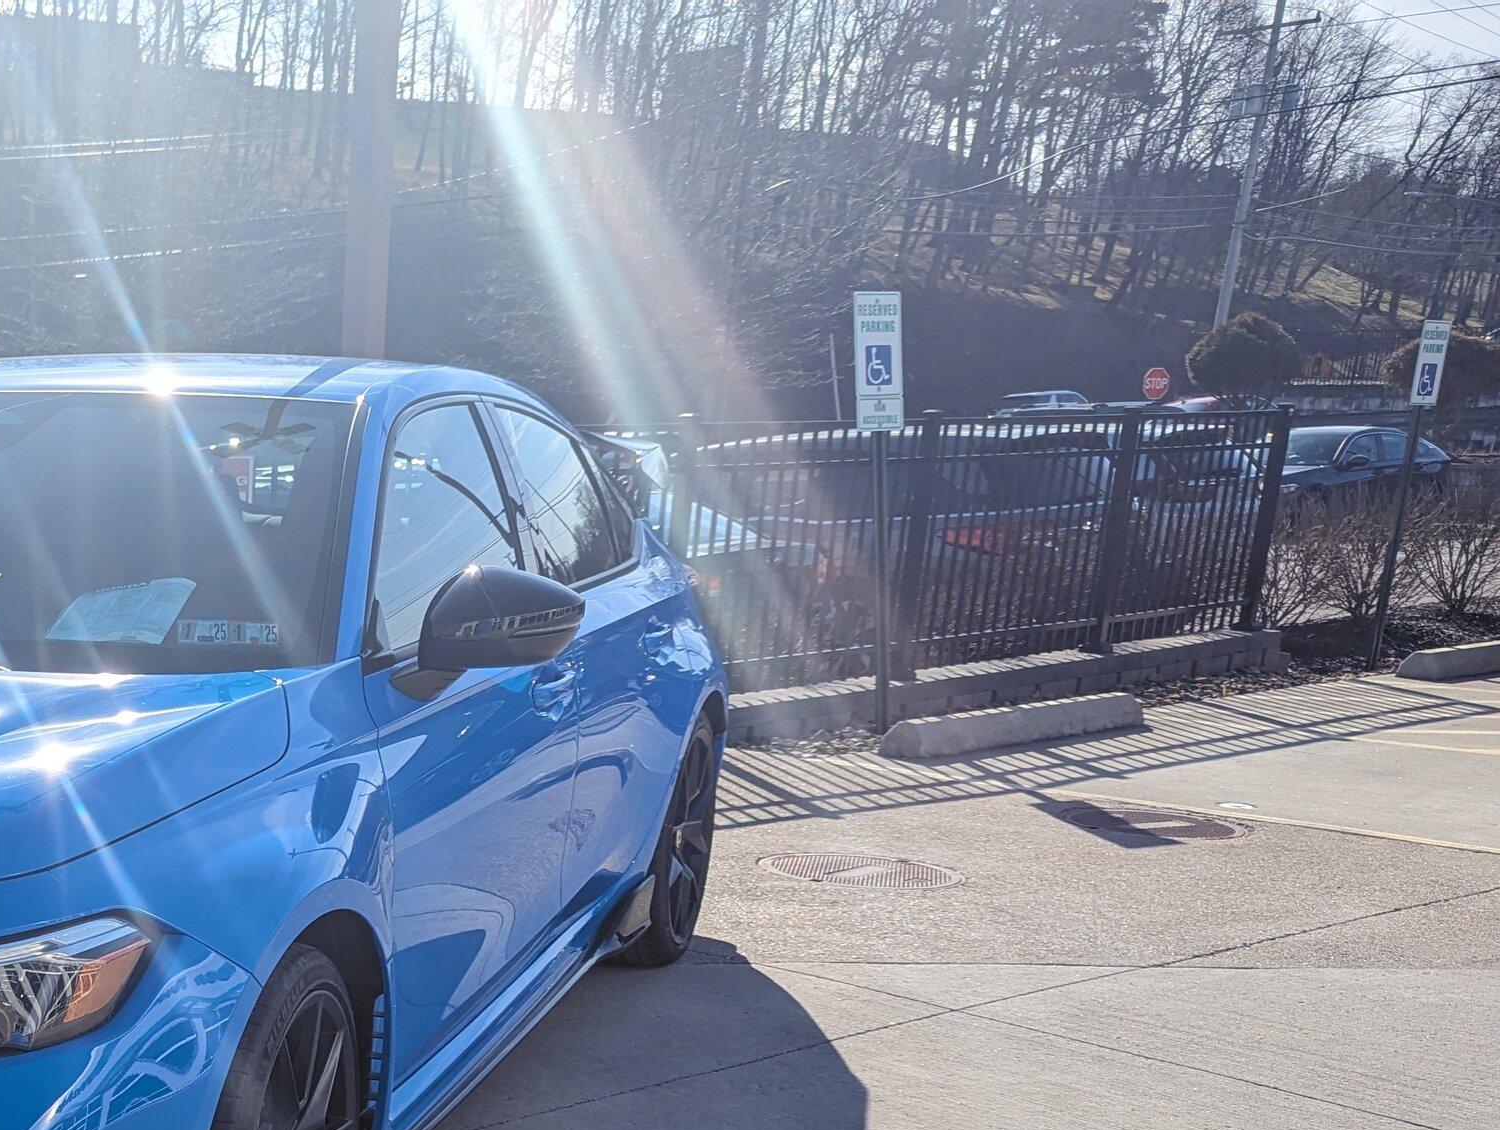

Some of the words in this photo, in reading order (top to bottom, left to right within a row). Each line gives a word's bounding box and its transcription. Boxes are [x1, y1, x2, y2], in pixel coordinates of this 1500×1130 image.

[858, 304, 897, 316] RESERVED
[861, 320, 896, 333] PARKING
[1422, 343, 1444, 353] PARKING
[1144, 378, 1168, 389] STOP
[862, 414, 898, 424] ACCESSIBLE
[214, 623, 227, 641] 25
[265, 625, 278, 643] 25
